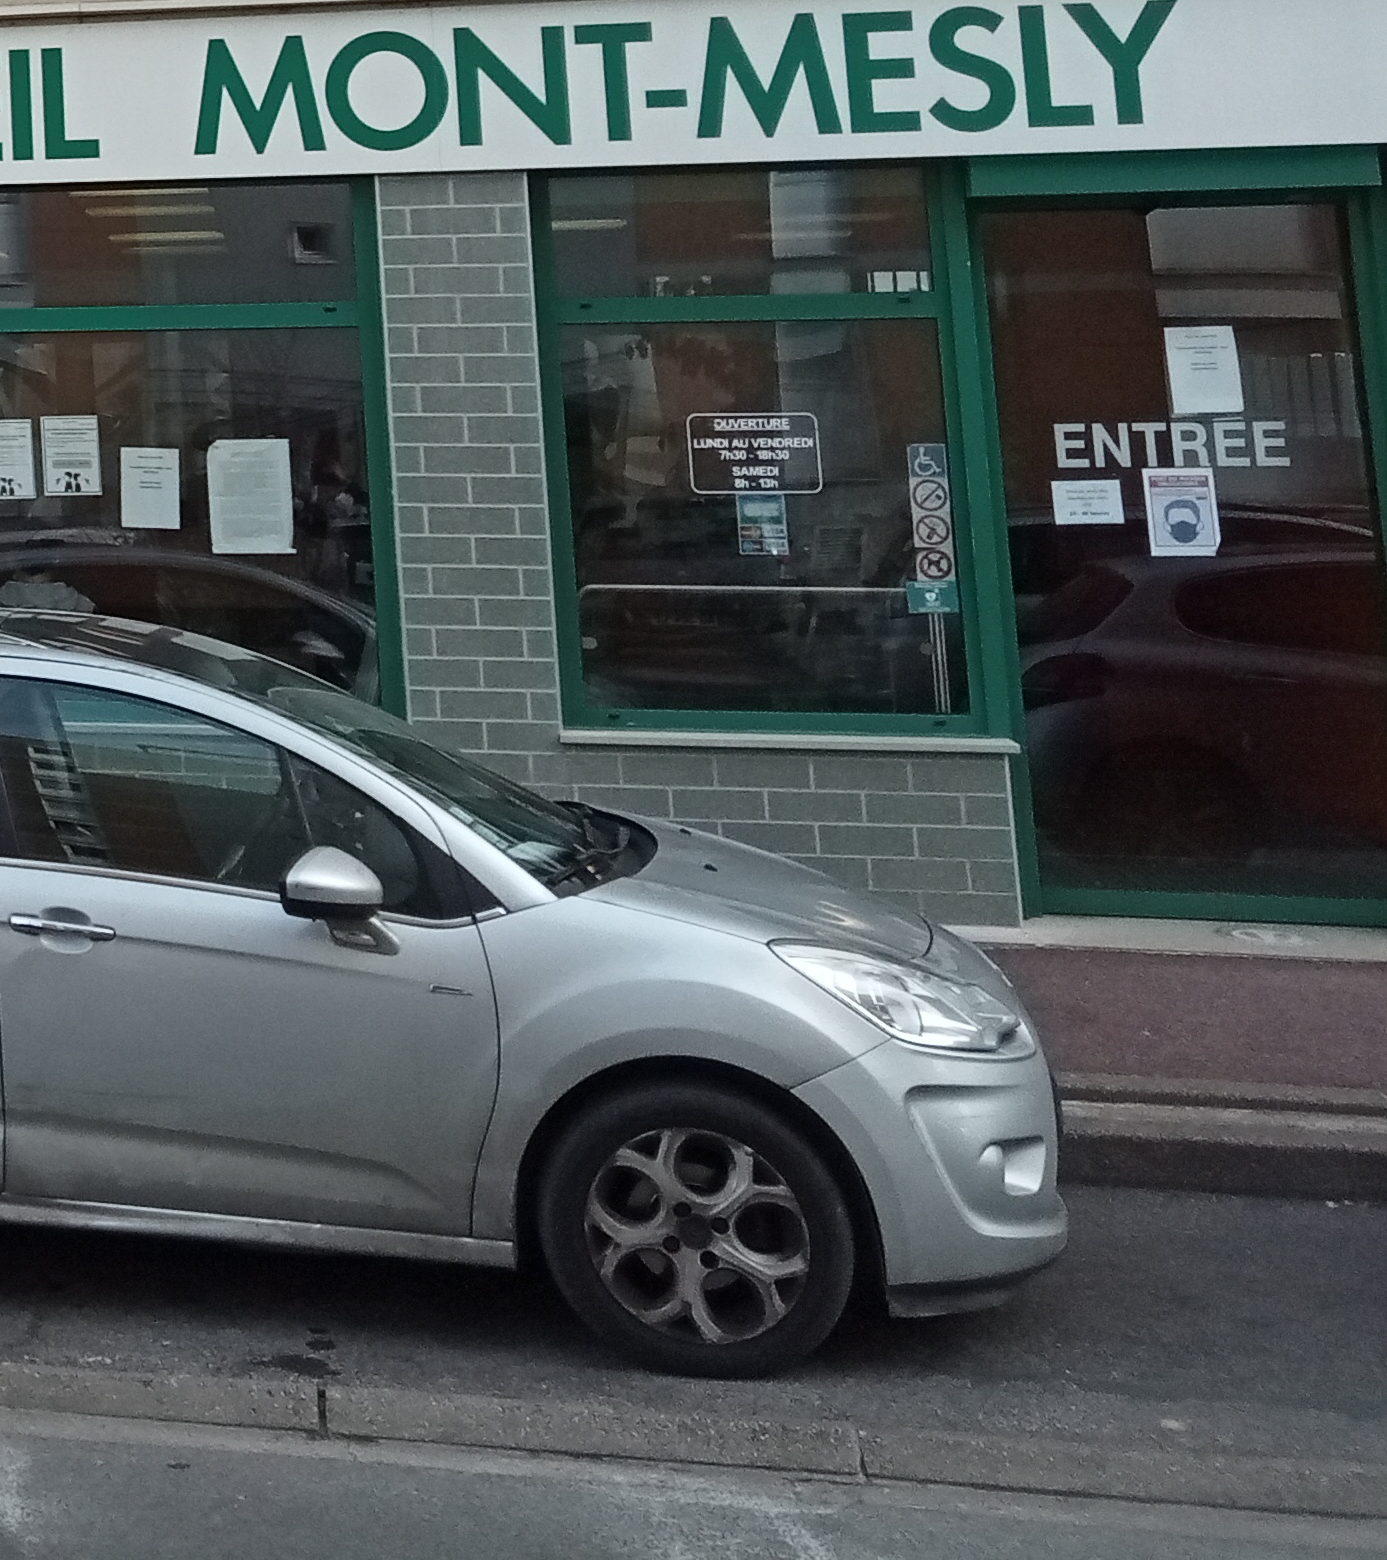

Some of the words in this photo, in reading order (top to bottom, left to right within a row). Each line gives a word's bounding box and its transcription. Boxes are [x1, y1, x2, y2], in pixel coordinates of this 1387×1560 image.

[713, 418, 791, 431] OUVERTURE
[693, 438, 729, 449] LUNDI
[731, 438, 749, 449] AU
[751, 437, 814, 448] VENDREDI
[1053, 416, 1292, 469] ENTRÉE
[718, 450, 747, 460] 7h30
[756, 450, 790, 460] 18h30
[732, 466, 780, 477] SAMEDI
[734, 478, 749, 488] 8h
[759, 478, 779, 488] 13h
